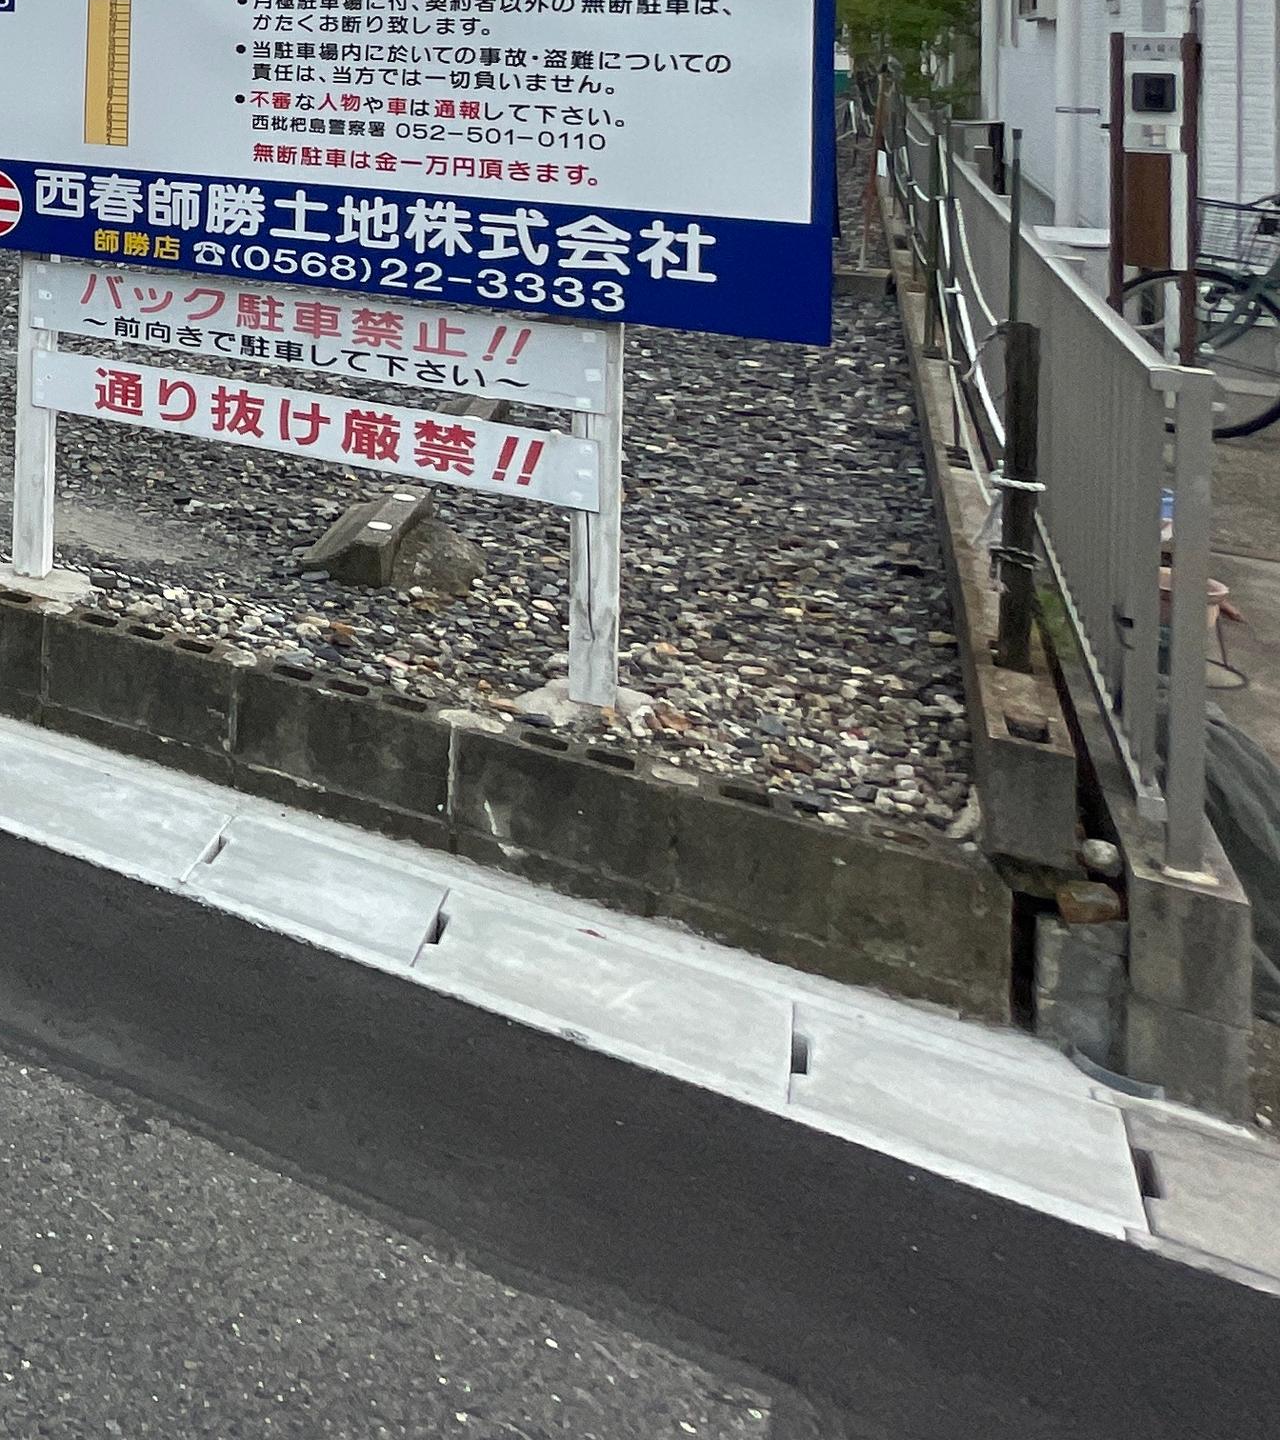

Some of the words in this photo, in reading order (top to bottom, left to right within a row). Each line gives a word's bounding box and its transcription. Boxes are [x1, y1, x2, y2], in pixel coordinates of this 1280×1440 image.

[252, 14, 490, 36] かたくお断り致します。
[251, 63, 615, 95] 責任は、当方では一切負いません。
[249, 91, 625, 127] 不審な人物や車は通報して下さい。
[252, 114, 385, 137] 西枇杷島警察署
[396, 123, 606, 150] 052-501-0110
[252, 143, 598, 186] 無断駐車は金一万円頂きます。
[34, 169, 718, 283] 西春師勝土地株式会社
[94, 229, 181, 260] 師勝店
[80, 273, 532, 365] バック駐車禁止!!
[94, 367, 545, 486] 通り抜け厳禁!!
